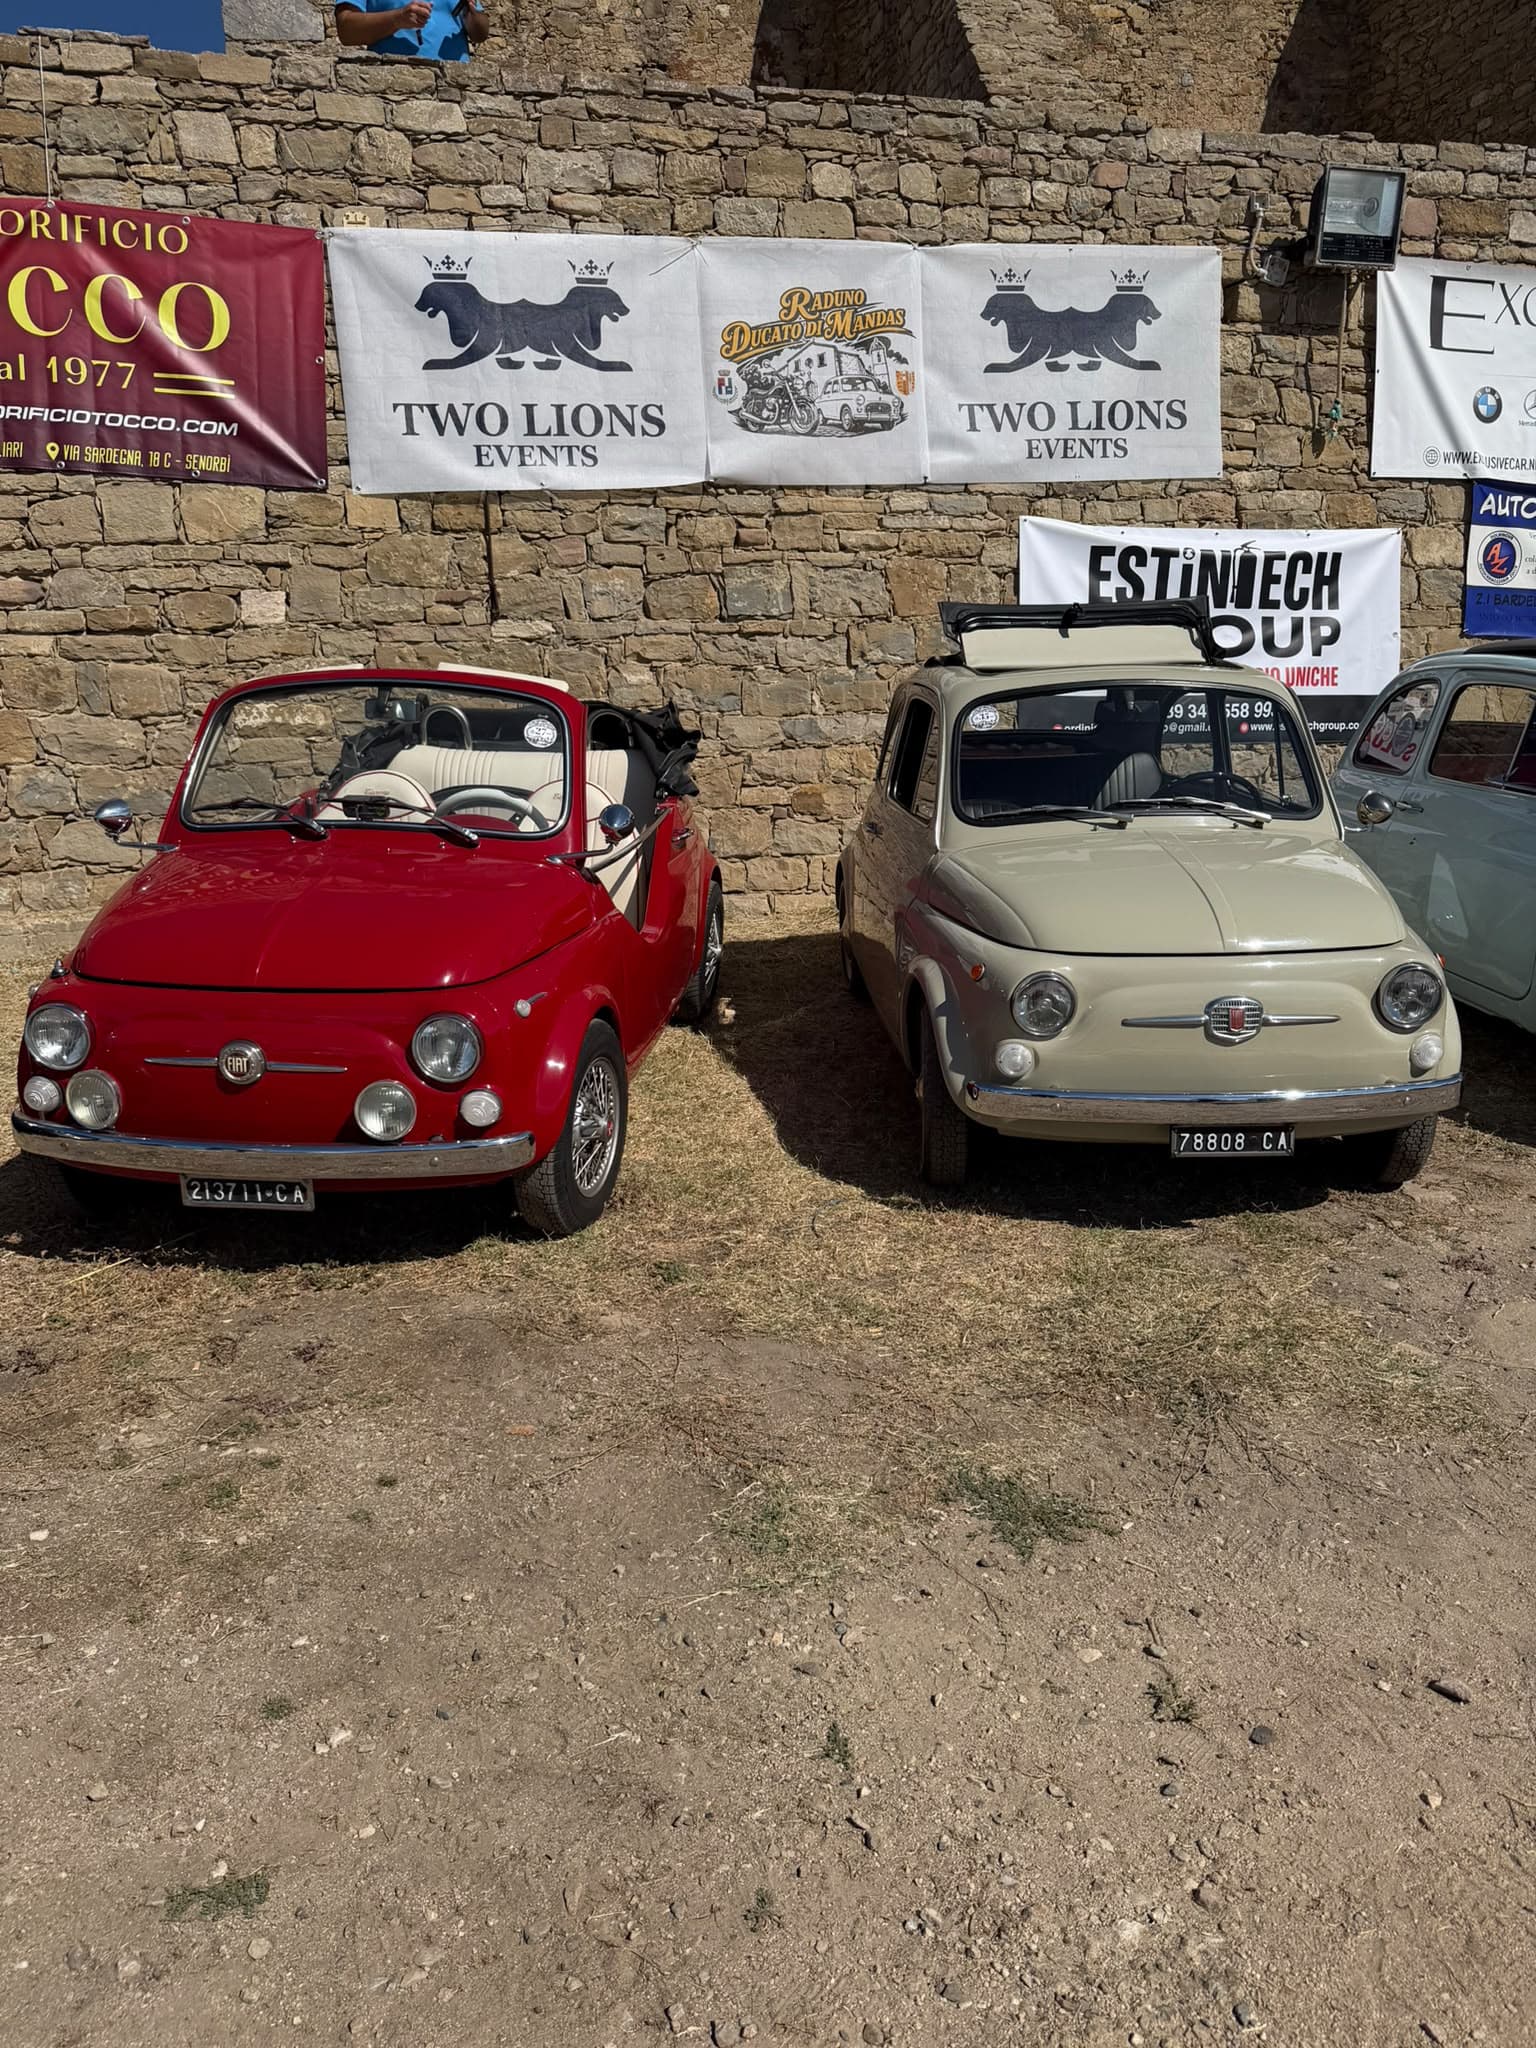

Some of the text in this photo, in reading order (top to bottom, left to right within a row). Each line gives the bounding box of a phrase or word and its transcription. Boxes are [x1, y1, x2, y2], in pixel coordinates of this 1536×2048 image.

[8, 266, 230, 352] CCO
[779, 287, 866, 321] RADUNO
[720, 309, 906, 359] DUCATO DI MANDAS
[46, 356, 136, 389] 1977
[392, 402, 666, 437] TWO LIONS
[958, 399, 1187, 433] TWO LIONS
[0, 442, 23, 458] IARI
[63, 445, 80, 461] VIA
[148, 451, 160, 467] 18
[163, 452, 171, 468] C
[473, 444, 598, 467] EVENTS
[1025, 438, 1128, 459] EVENTS
[1285, 666, 1339, 687] UNICHE
[227, 1056, 249, 1073] FIAT
[1180, 1132, 1287, 1151] 78808 CA
